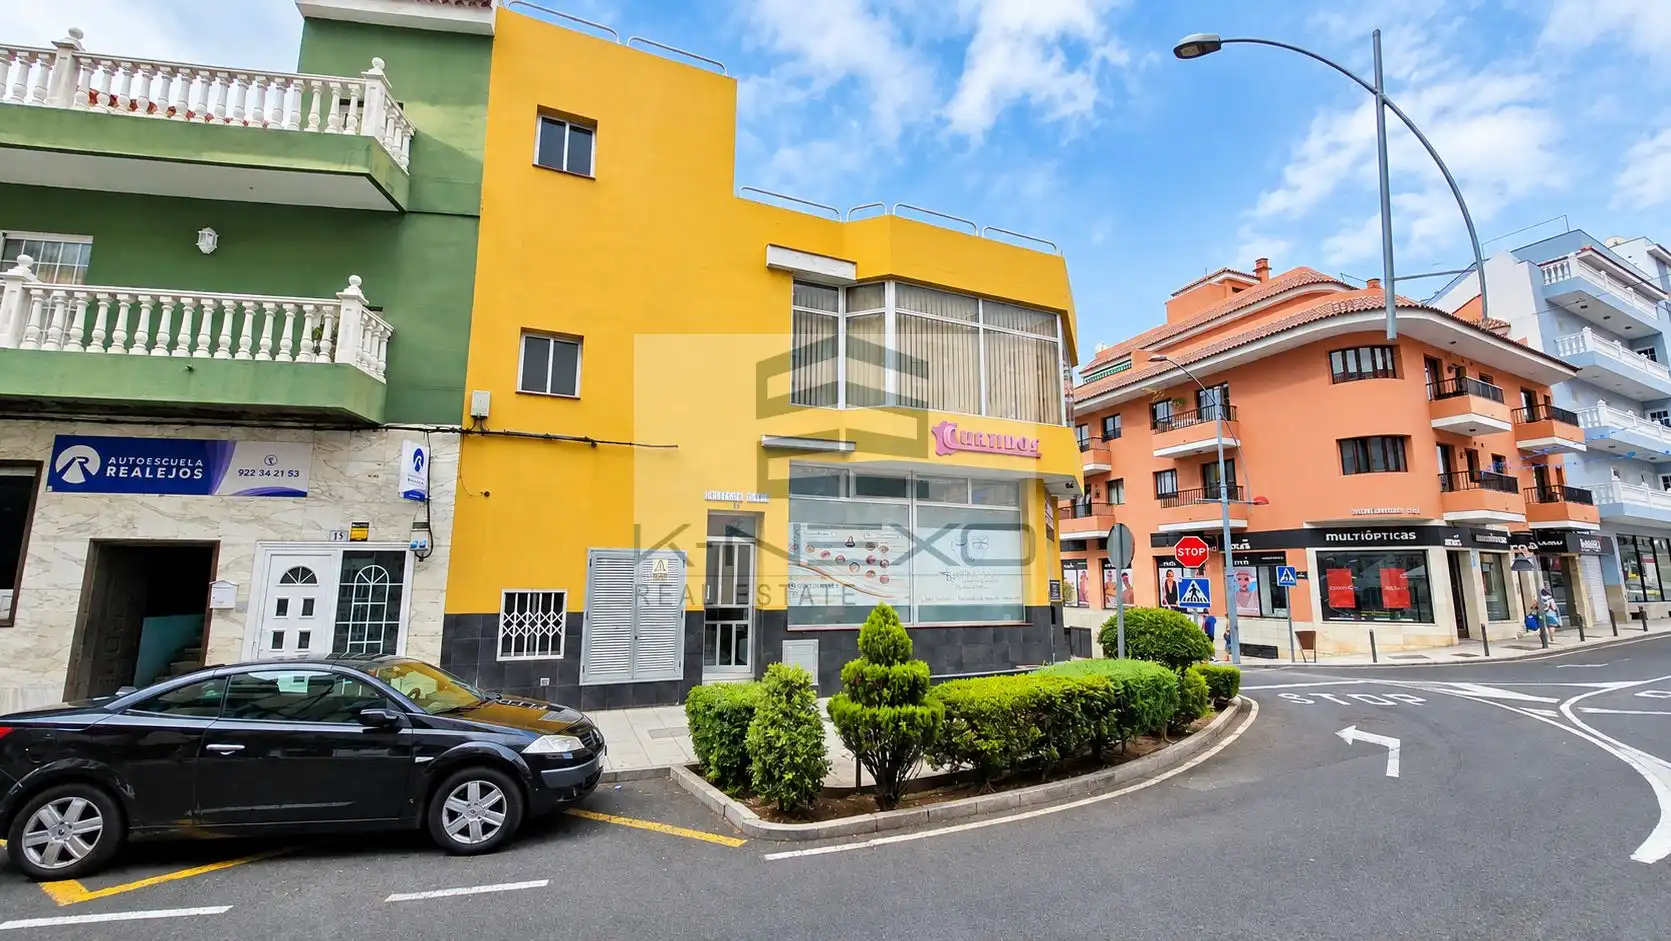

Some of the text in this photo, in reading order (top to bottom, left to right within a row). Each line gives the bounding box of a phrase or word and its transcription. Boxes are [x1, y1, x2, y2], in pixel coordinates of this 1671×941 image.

[108, 456, 203, 467] AUTOESCUELA
[106, 466, 203, 479] REALEJOS
[238, 469, 255, 477] 922
[259, 469, 271, 477] 34
[287, 470, 300, 478] 53
[1177, 547, 1206, 556] STOP
[1277, 692, 1427, 706] STOP
